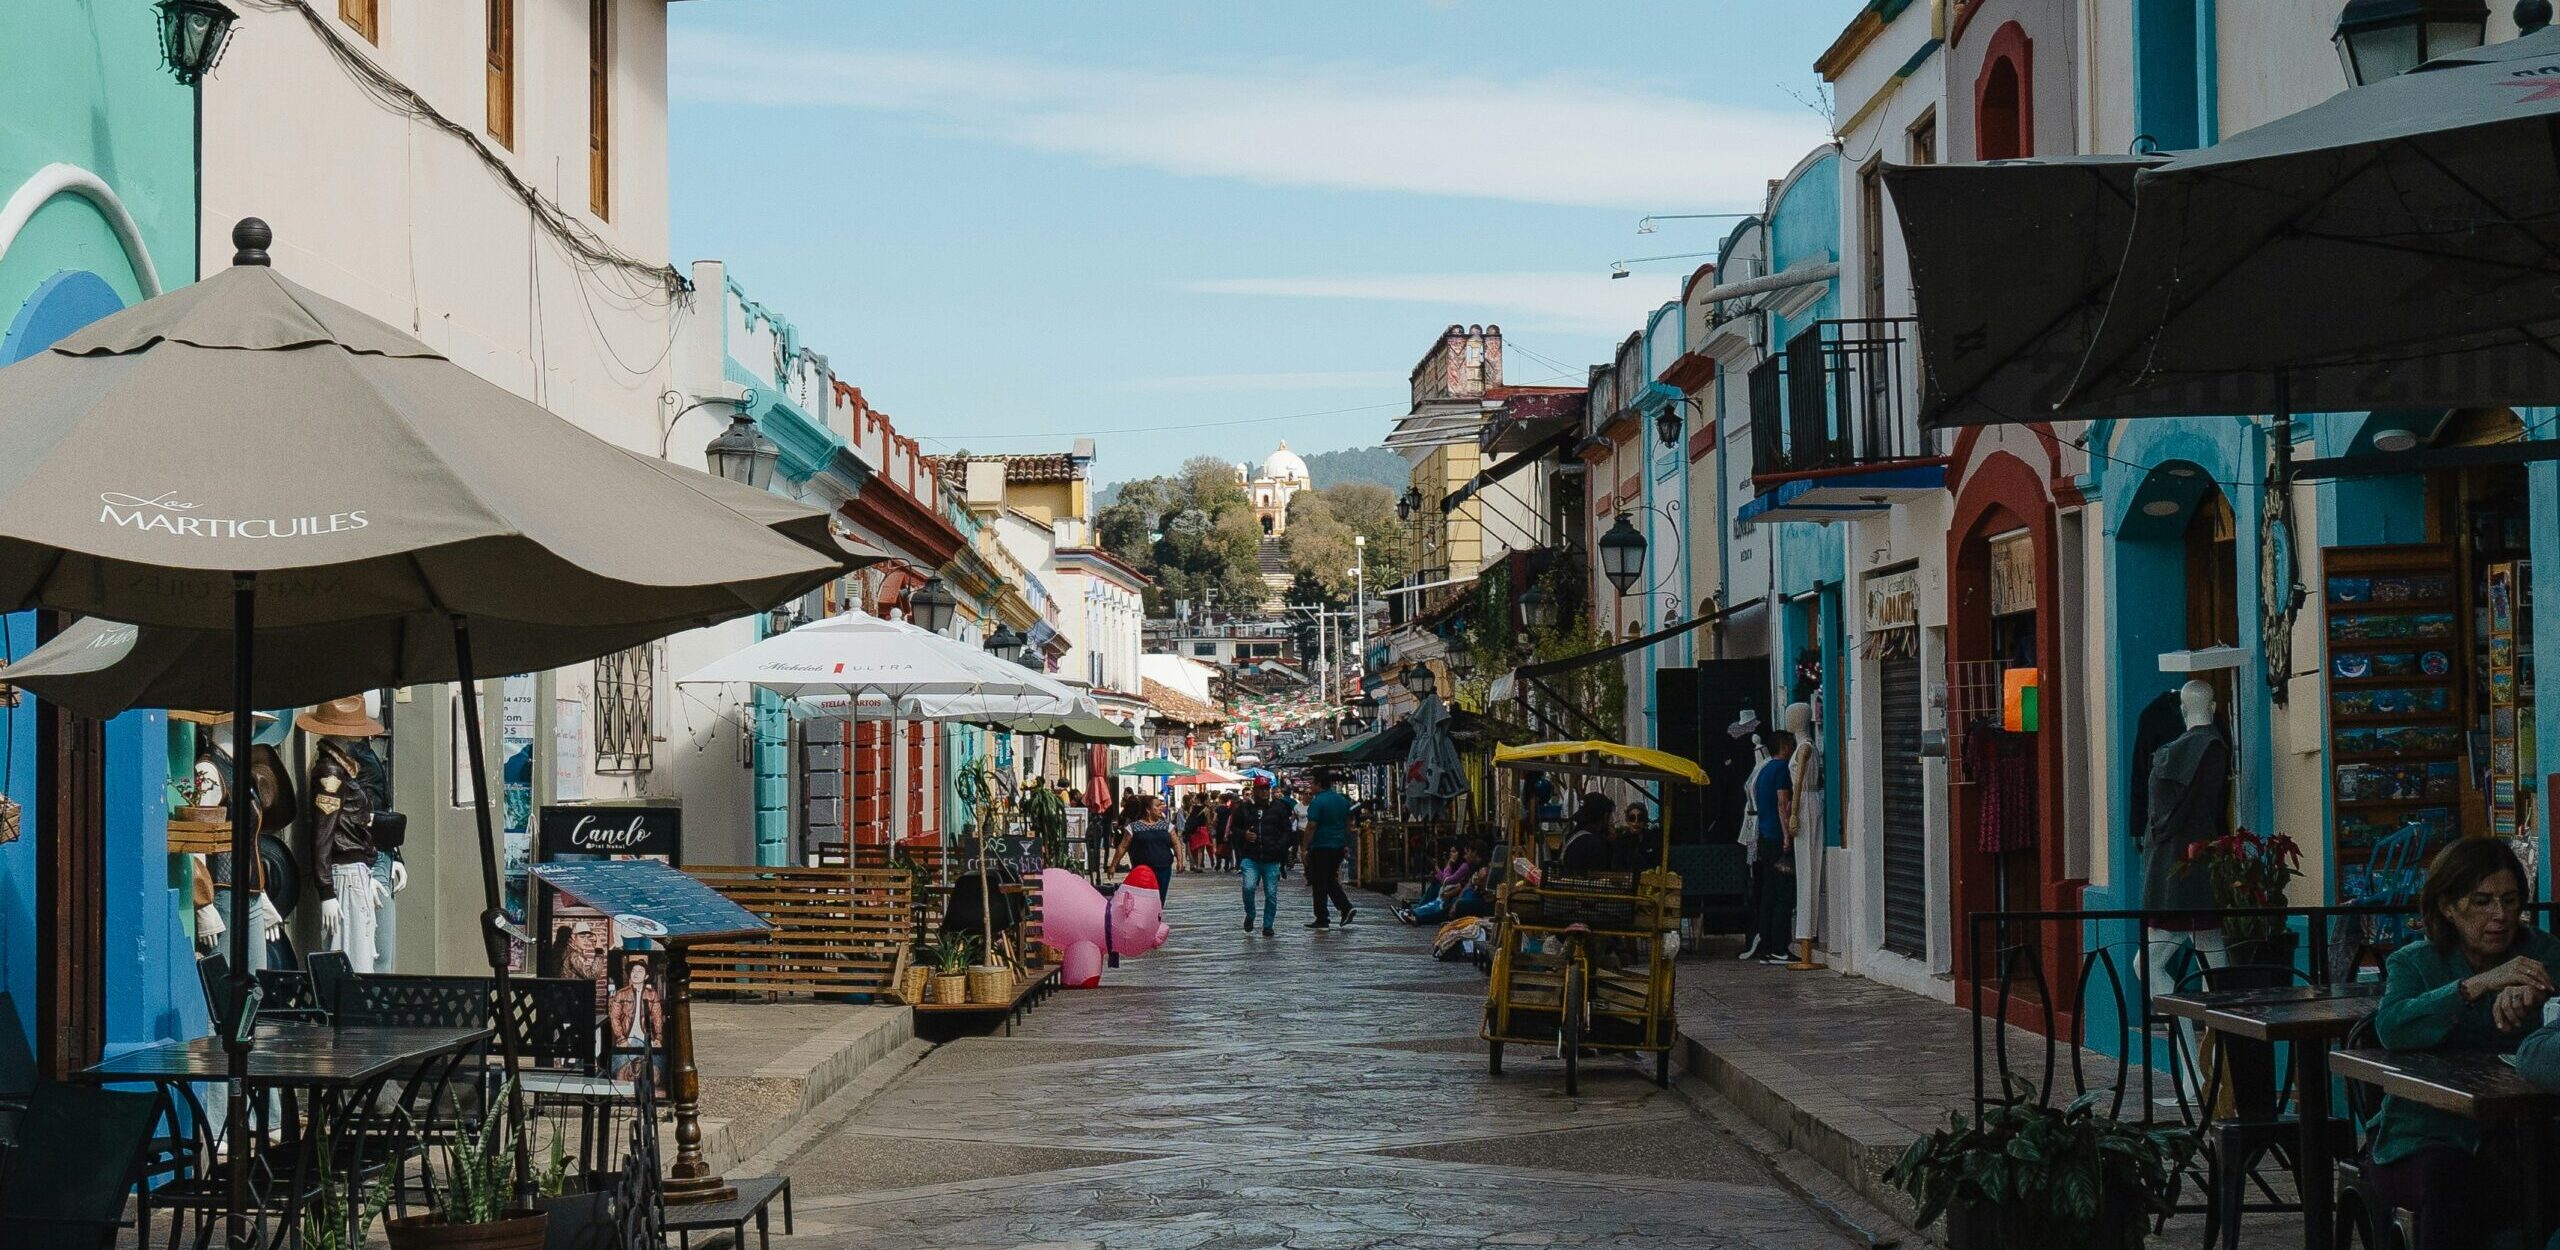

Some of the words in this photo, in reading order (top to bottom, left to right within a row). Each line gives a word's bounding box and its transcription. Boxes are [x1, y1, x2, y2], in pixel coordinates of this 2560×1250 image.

[100, 490, 204, 511] Los
[99, 504, 369, 538] MARTICUILES
[758, 661, 824, 672] Michelob
[820, 699, 846, 708] STELLA
[571, 814, 652, 847] Canelo
